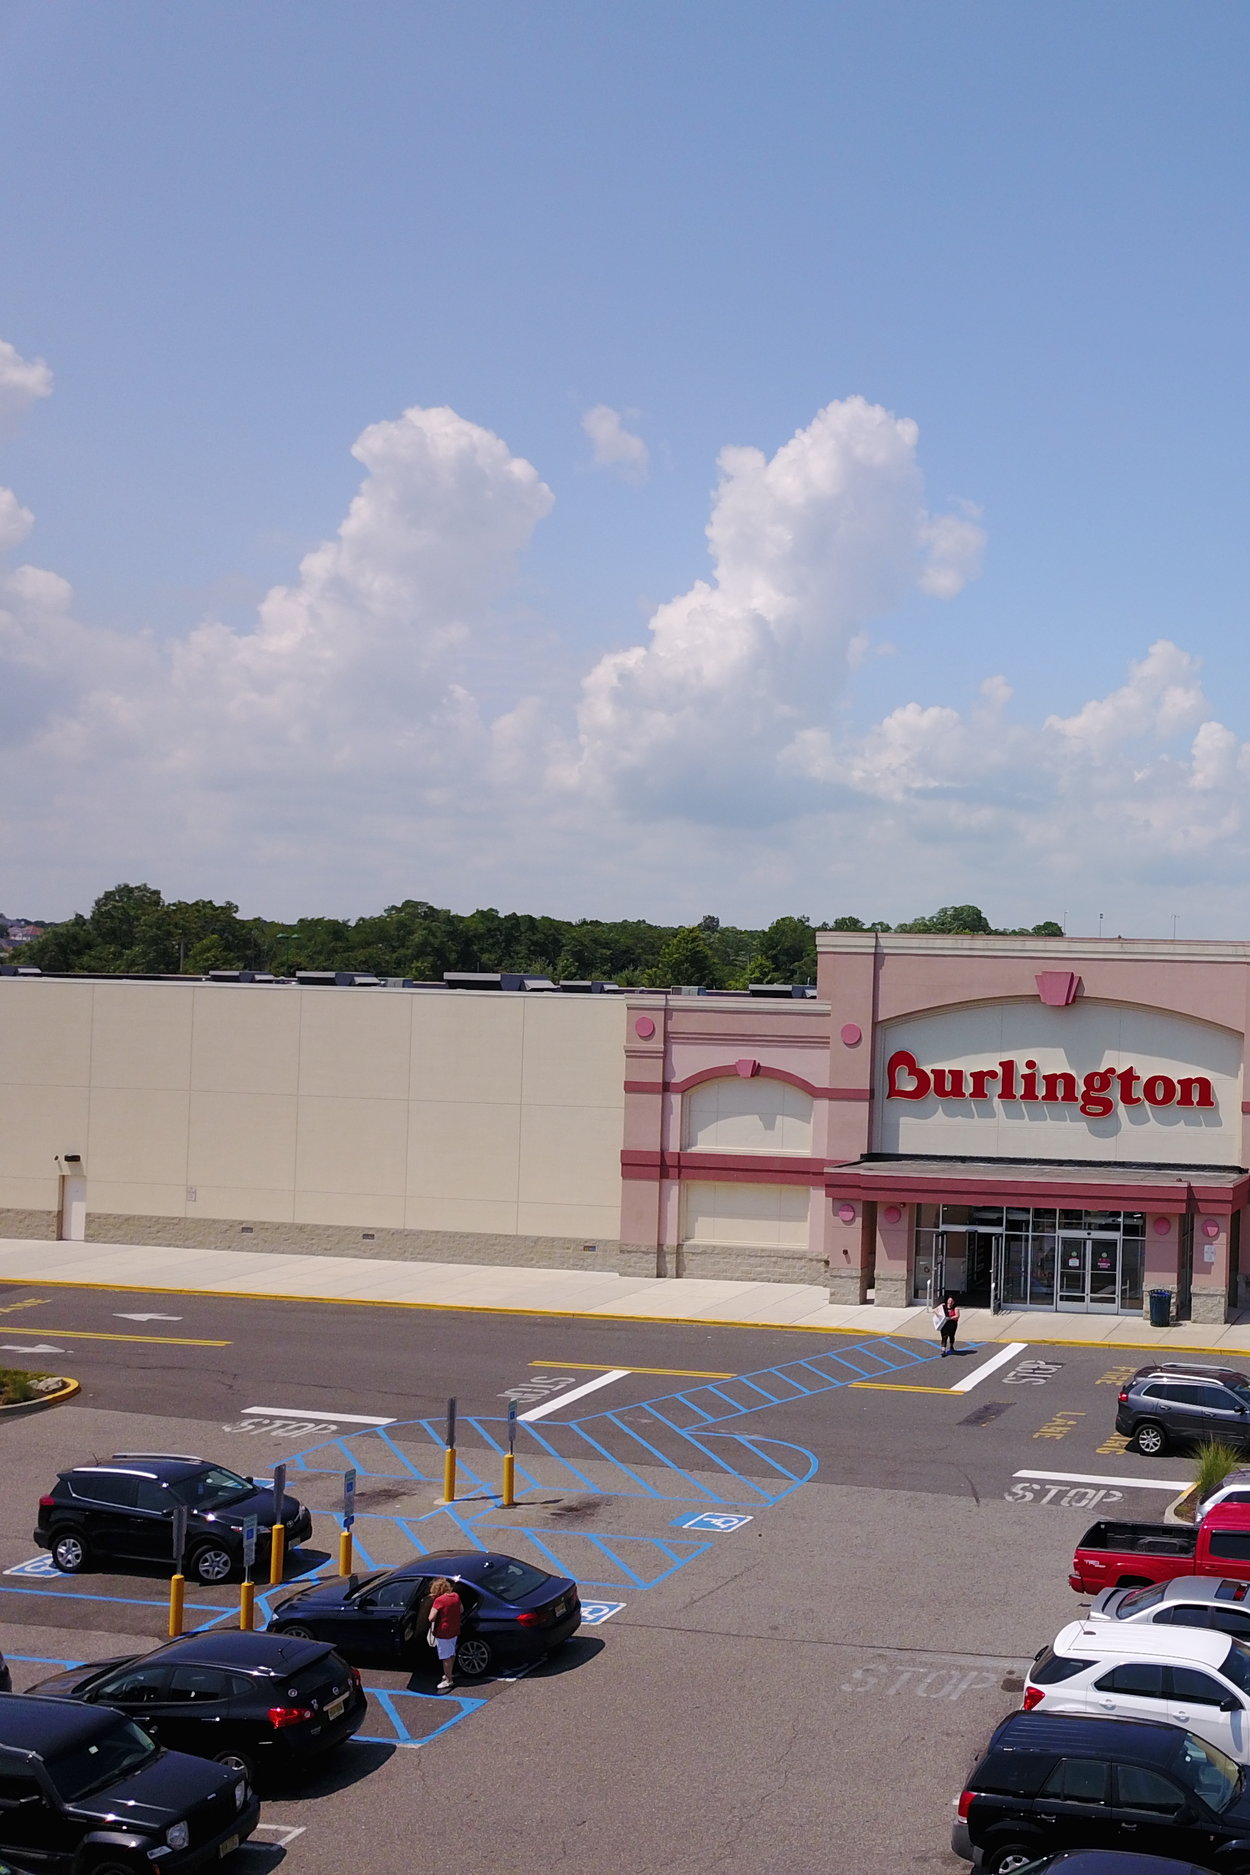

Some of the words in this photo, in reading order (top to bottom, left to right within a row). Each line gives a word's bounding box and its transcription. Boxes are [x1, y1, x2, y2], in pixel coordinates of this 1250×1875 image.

[887, 1050, 1215, 1118] Burlington
[1001, 1359, 1063, 1386] STOP
[221, 1418, 339, 1438] STOP
[1003, 1482, 1125, 1510] STOP
[839, 1663, 998, 1701] STOP
